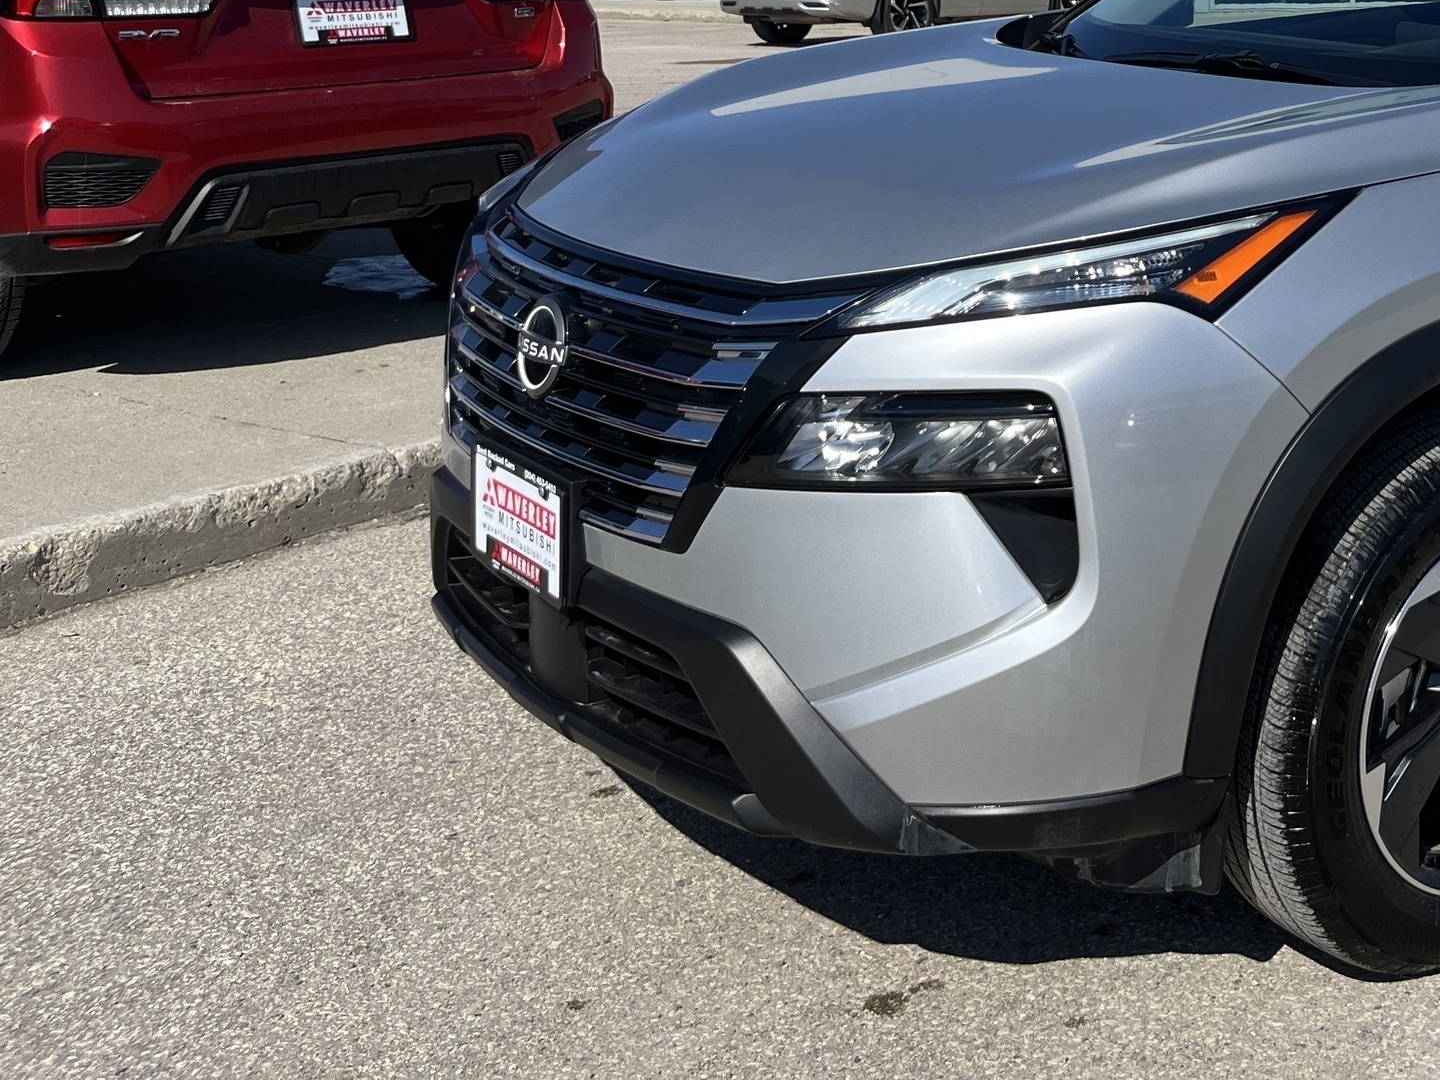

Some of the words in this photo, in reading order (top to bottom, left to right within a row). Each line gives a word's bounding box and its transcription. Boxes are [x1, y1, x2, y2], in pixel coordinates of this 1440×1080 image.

[323, 0, 397, 13] WAVERLEY
[327, 11, 398, 22] MITSUBISHI
[119, 29, 180, 40] RVR
[338, 27, 386, 37] WAVERLEY
[497, 482, 556, 536] WAVERLEY
[498, 510, 556, 556] MITSUBISHI
[501, 546, 540, 582] WAVERLEY
